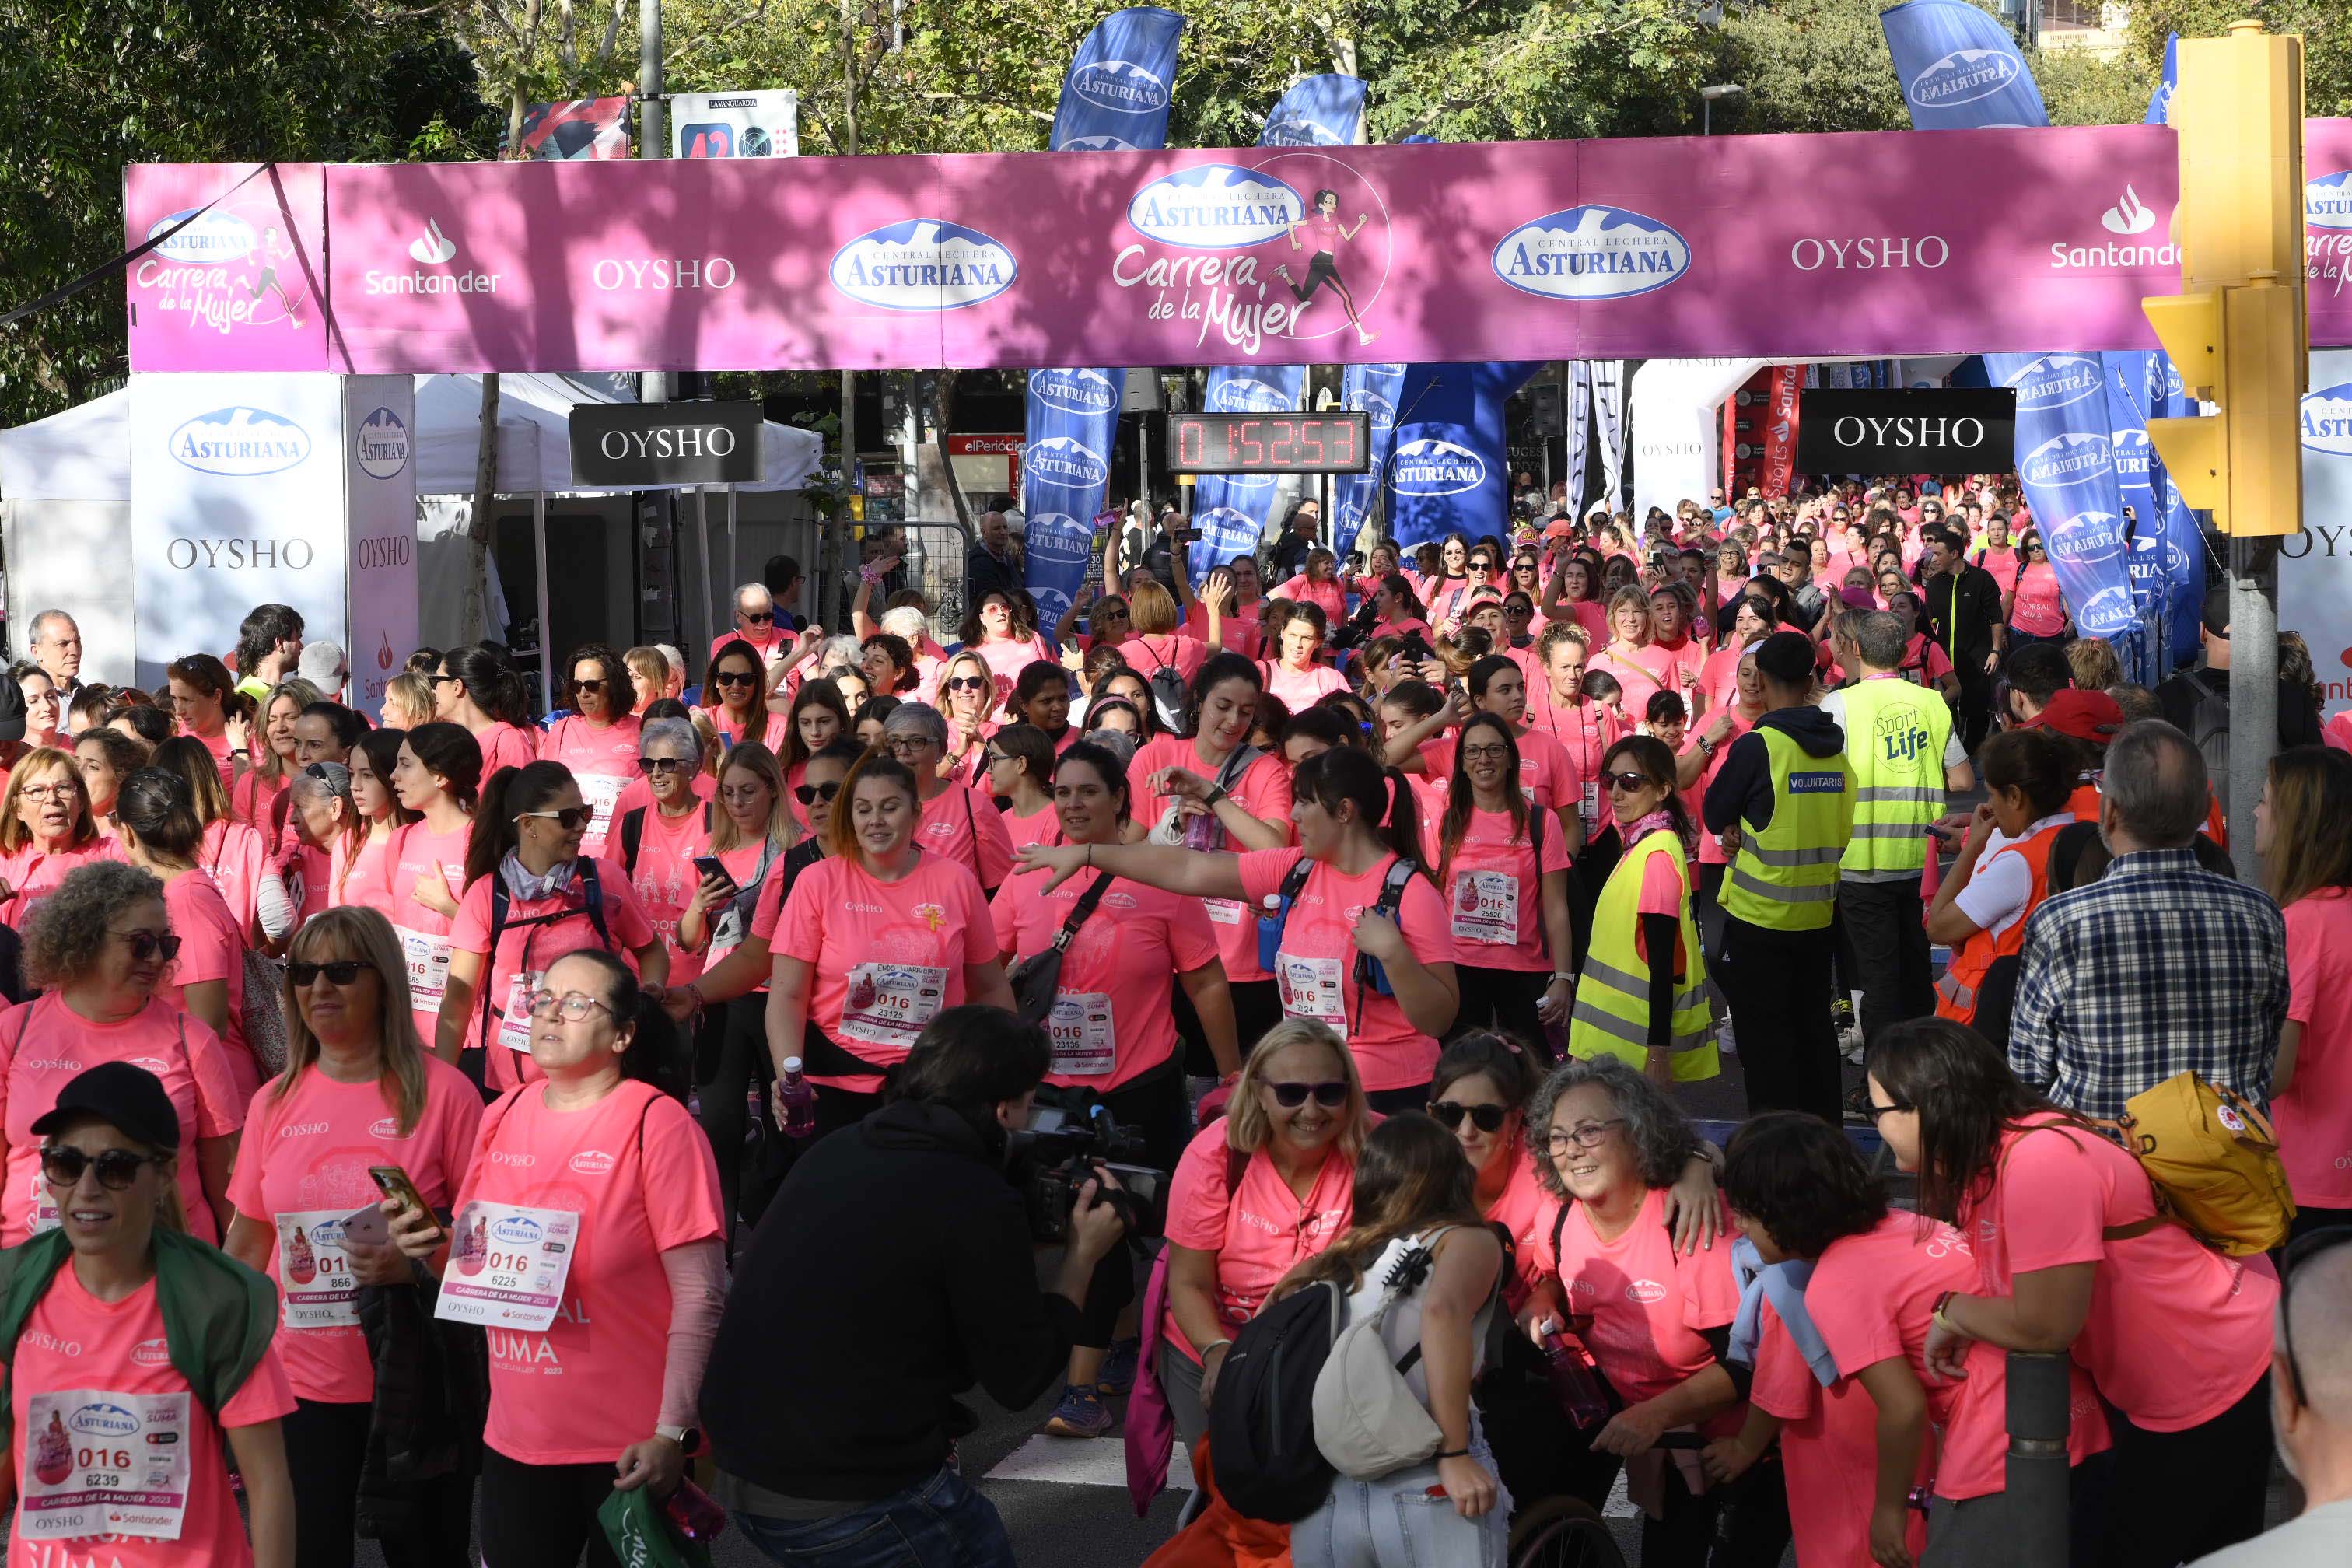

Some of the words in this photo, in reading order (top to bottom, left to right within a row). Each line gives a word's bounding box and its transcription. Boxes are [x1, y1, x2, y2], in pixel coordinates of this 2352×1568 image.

[1078, 72, 1160, 107] ASTURIANA
[1230, 191, 1286, 201] LECHERA
[1141, 196, 1290, 228] ASTURIANA
[155, 228, 248, 250] ASTURIANA
[1538, 237, 1599, 249] CENTRAL
[1605, 236, 1668, 247] LECHERA
[936, 248, 996, 259] LECHERA
[1508, 241, 1675, 278] ASTURIANA
[1791, 236, 1950, 271] OYSHO
[136, 259, 228, 289] Carrera
[593, 257, 737, 290] OYSHO
[844, 254, 1004, 287] ASTURIANA
[1112, 244, 1258, 287] Carrera
[2323, 257, 2338, 278] la
[366, 269, 501, 295] Santander
[159, 292, 177, 310] de
[180, 289, 192, 310] la
[189, 288, 262, 334] Mujer
[1148, 291, 1175, 320] de
[1181, 289, 1201, 320] la
[1195, 282, 1313, 355] Mujer
[1037, 376, 1111, 407] ASTURIANA
[1834, 416, 1984, 448] OYSHO
[180, 432, 300, 460] ASTURIANA
[360, 438, 406, 462] ASTURIANA
[601, 426, 736, 462] OYSHO
[1181, 422, 1354, 465] 01:52:53
[1031, 450, 1101, 481] ASTURIANA
[1391, 460, 1479, 482] ASTURIANA
[1766, 445, 1787, 499] Sports
[166, 538, 313, 569] OYSHO
[358, 534, 410, 569] OYSHO
[1091, 555, 1101, 564] 30
[2021, 610, 2042, 618] SUMA
[1876, 708, 1920, 737] Sport
[1885, 726, 1927, 761] Life
[1790, 774, 1843, 791] VOLUNTARIS
[845, 901, 884, 914] OYSHO
[1480, 898, 1505, 909] 016
[1481, 910, 1502, 919] 25526
[1458, 926, 1482, 934] OYSHO
[877, 964, 896, 972] ENDO
[880, 978, 915, 989] ASTURIANA
[877, 993, 910, 1010] 016
[1293, 989, 1316, 1003] 016
[878, 1008, 904, 1019] 23125
[848, 1024, 877, 1037] OYSHO
[894, 1021, 914, 1030] MUJER
[1052, 1026, 1083, 1038] 016
[30, 1059, 82, 1071] OYSHO
[1081, 1061, 1108, 1069] Santander
[281, 1122, 330, 1139] OYSHO
[491, 1150, 536, 1167] OYSHO
[496, 1224, 538, 1240] ASTURIANA
[547, 1225, 570, 1235] SUMA
[489, 1251, 529, 1272] 016
[331, 1277, 351, 1288] 866
[492, 1275, 516, 1288] 6225
[297, 1293, 328, 1302] CARRERA
[329, 1293, 341, 1301] DE
[341, 1293, 350, 1301] LA
[455, 1286, 488, 1297] CARRERA
[498, 1292, 508, 1300] LA
[509, 1293, 533, 1303] MUJER
[533, 1297, 549, 1305] 2023
[296, 1309, 331, 1320] OYSHO
[448, 1301, 485, 1316] OYSHO
[511, 1310, 547, 1322] Santander
[22, 1328, 82, 1357] OYSHO
[544, 1367, 562, 1375] 2023
[75, 1416, 135, 1432] ASTURIANA
[145, 1412, 177, 1423] SUMA
[78, 1447, 131, 1468] 016
[86, 1474, 120, 1487] 6239
[40, 1494, 84, 1507] CARRERA
[84, 1493, 97, 1503] DE
[99, 1493, 111, 1502] LA
[112, 1493, 147, 1503] MUJER
[149, 1496, 171, 1505] 2023
[36, 1514, 85, 1531] OYSHO
[122, 1513, 174, 1526] Santander
